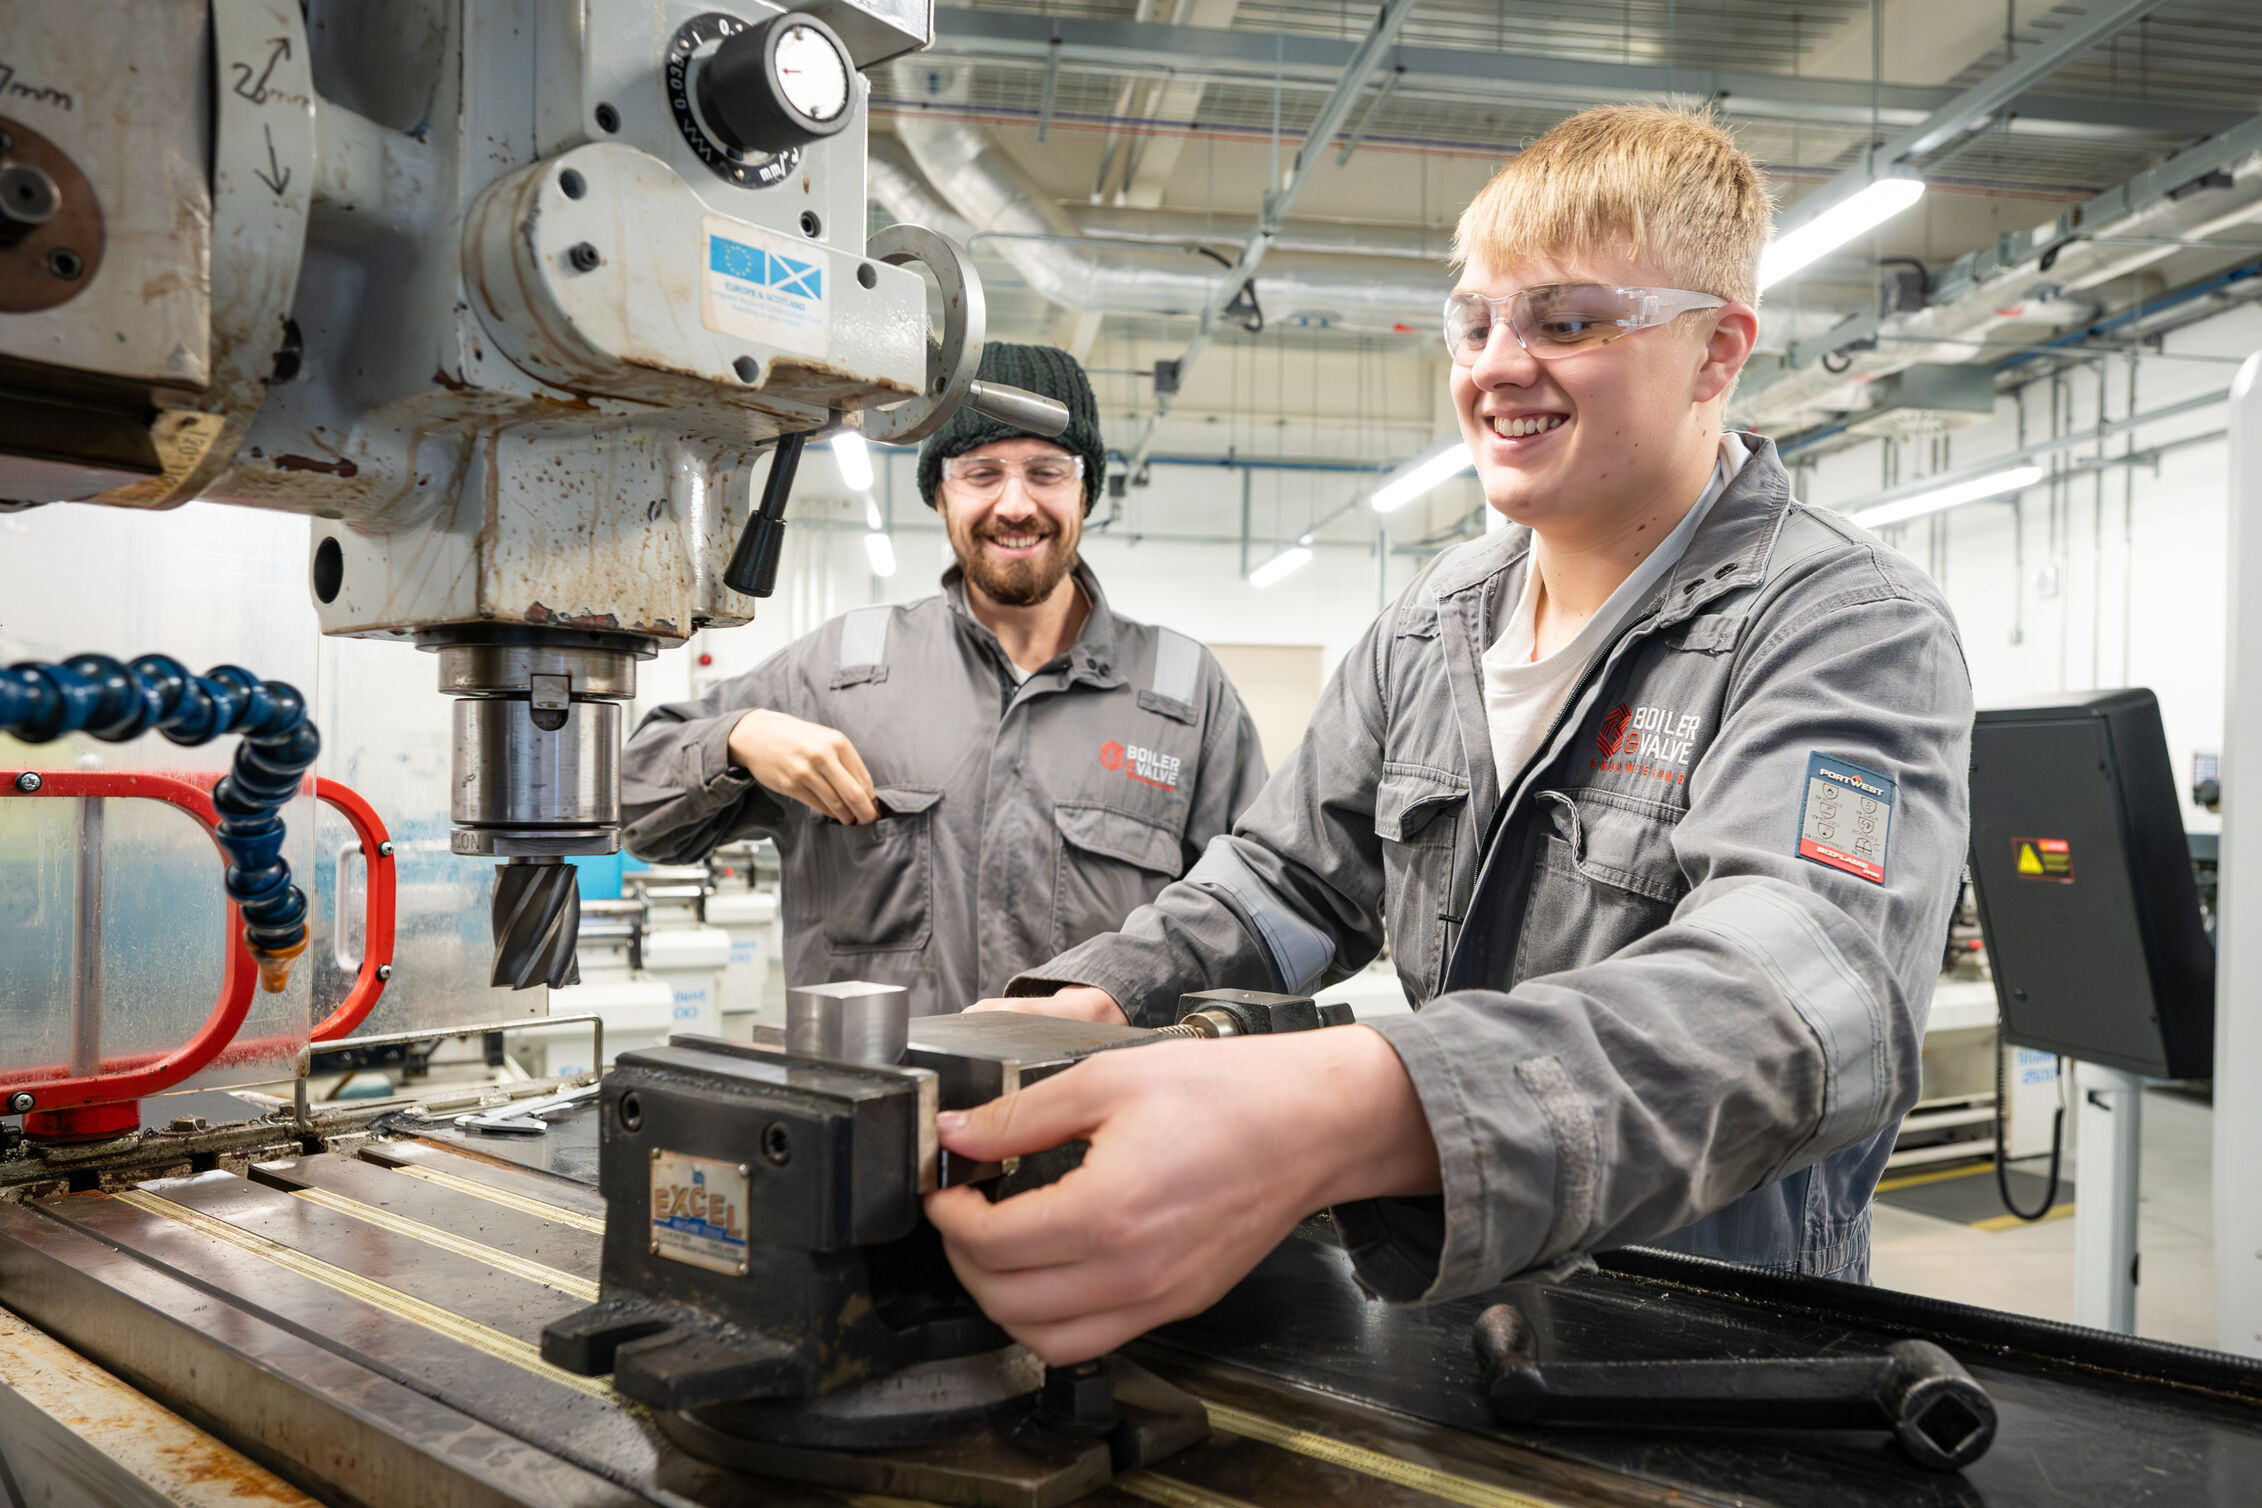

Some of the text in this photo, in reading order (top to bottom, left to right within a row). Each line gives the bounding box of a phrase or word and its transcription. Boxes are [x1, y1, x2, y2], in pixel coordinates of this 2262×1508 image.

[725, 281, 756, 298] EUROPE
[766, 292, 806, 311] SCOTLAND
[1632, 706, 1701, 741] BOILER
[1126, 744, 1181, 773] BOILER
[1639, 732, 1694, 765] VALVE
[1135, 761, 1178, 786] VALVE
[1819, 768, 1885, 797] PORTWEST
[654, 1184, 744, 1238] EXCEL
